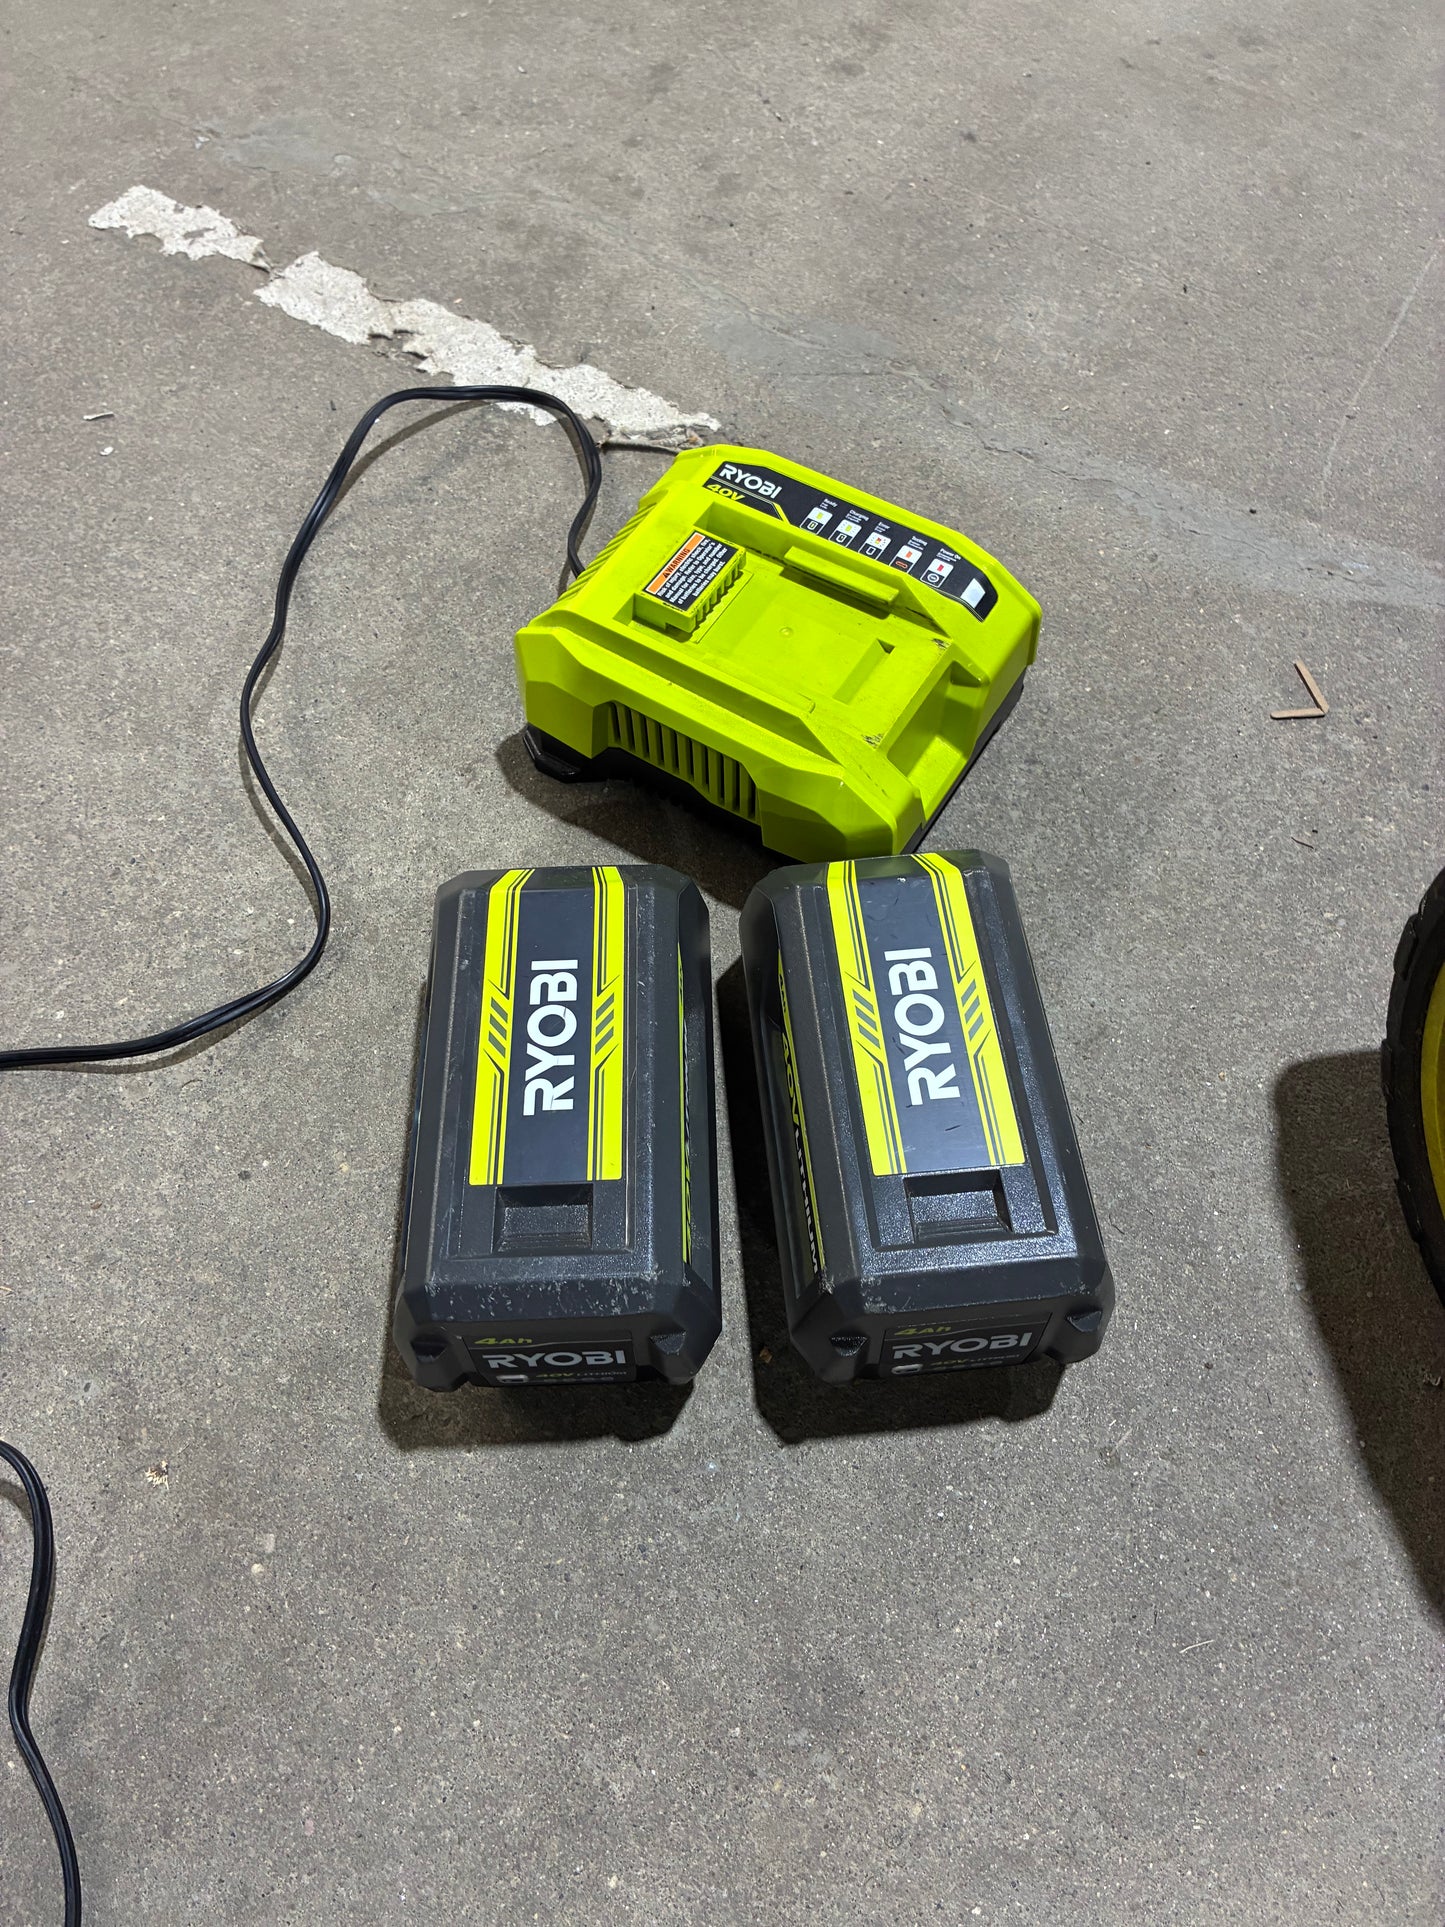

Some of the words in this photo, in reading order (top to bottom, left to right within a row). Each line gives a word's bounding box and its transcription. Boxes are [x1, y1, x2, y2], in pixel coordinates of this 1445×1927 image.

[707, 484, 746, 500] 40V
[719, 464, 782, 499] RYOBI
[667, 549, 690, 572] WARNING
[523, 960, 579, 1116] RYOBI
[884, 948, 961, 1106] RYOBI
[474, 1337, 533, 1346] 4Ah
[894, 1326, 952, 1336] 4Ah
[892, 1332, 1033, 1360] RYOBI
[482, 1350, 627, 1369] RYOBI
